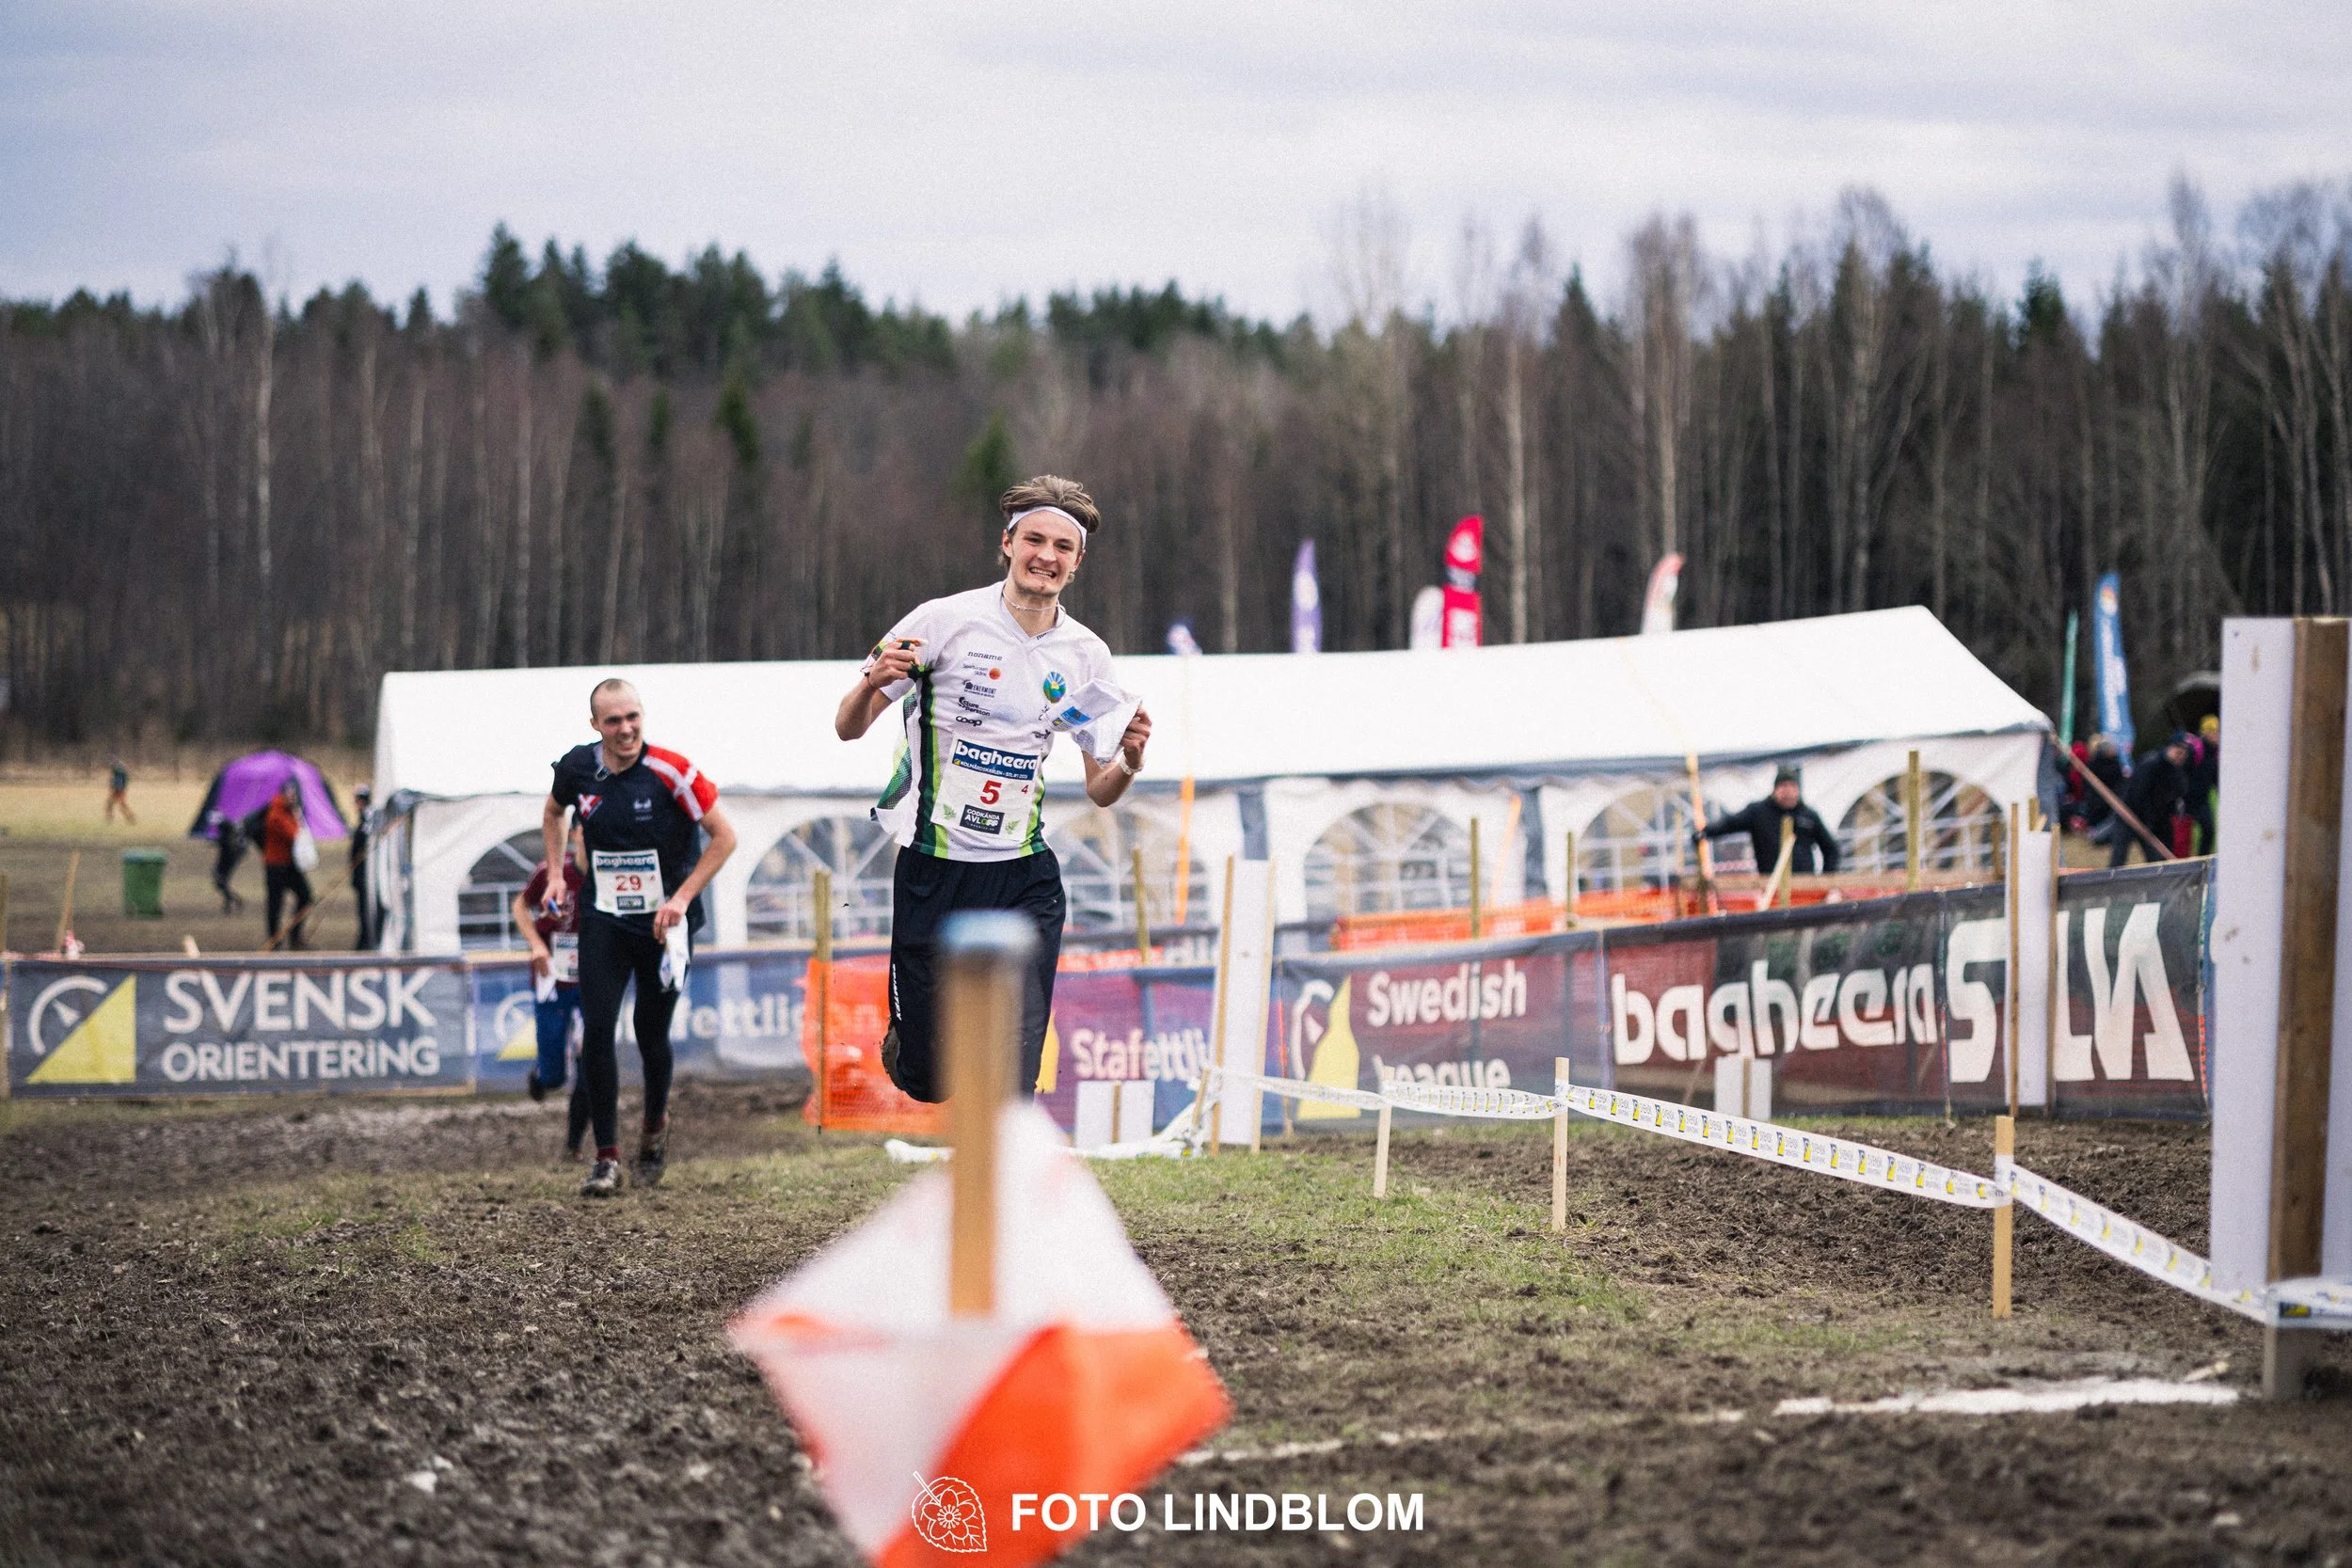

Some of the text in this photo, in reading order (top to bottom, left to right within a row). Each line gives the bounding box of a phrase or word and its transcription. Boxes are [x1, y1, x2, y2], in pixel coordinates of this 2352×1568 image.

[956, 715, 983, 727] coop
[955, 740, 1037, 770] bagheera
[979, 780, 1002, 805] 5
[1021, 784, 1029, 794] 4
[615, 875, 642, 892] 29
[163, 968, 437, 1034] SVENSK
[1367, 960, 1528, 1028] Swedish
[1613, 959, 1938, 1065] bagheera
[1947, 902, 2195, 1083] SLVA
[160, 1035, 441, 1083] ORIENTERING
[1070, 1027, 1213, 1082] Stafettli
